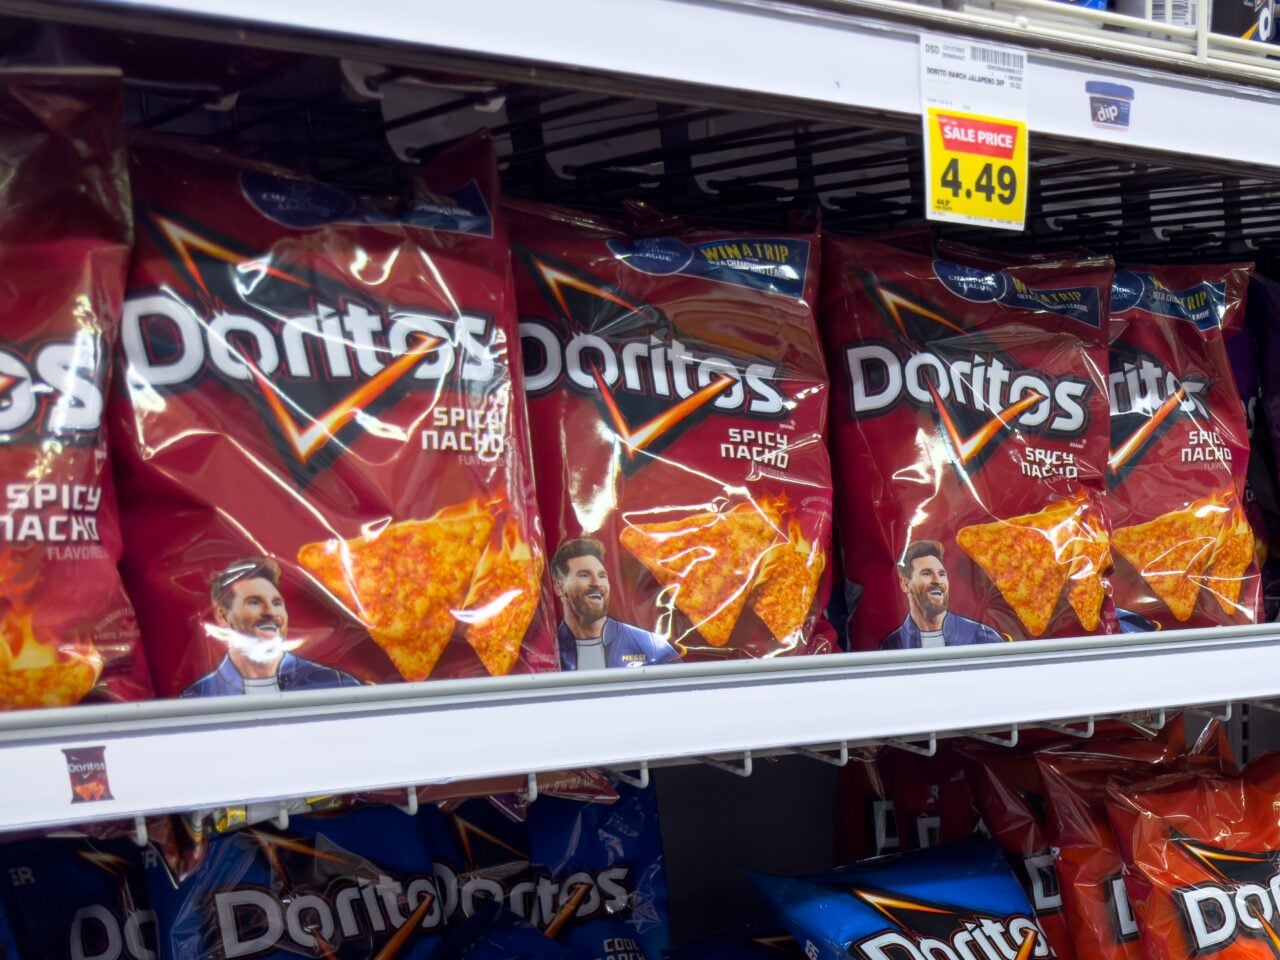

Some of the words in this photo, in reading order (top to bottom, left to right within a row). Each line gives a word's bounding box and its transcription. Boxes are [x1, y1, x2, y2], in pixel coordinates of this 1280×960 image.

[943, 125, 975, 143] SALE
[977, 130, 1014, 148] PRICE
[940, 157, 1017, 206] 4.49
[757, 243, 789, 263] TRIP
[121, 298, 496, 390] Doritos
[518, 322, 783, 413] Doritos
[846, 344, 1088, 432] Doritos
[1109, 359, 1206, 421] ritos
[728, 428, 788, 447] SPICY
[1025, 447, 1074, 464] SPICY
[720, 444, 790, 469] NACHO
[6, 484, 101, 510] SPICY
[213, 870, 440, 960] Dorito
